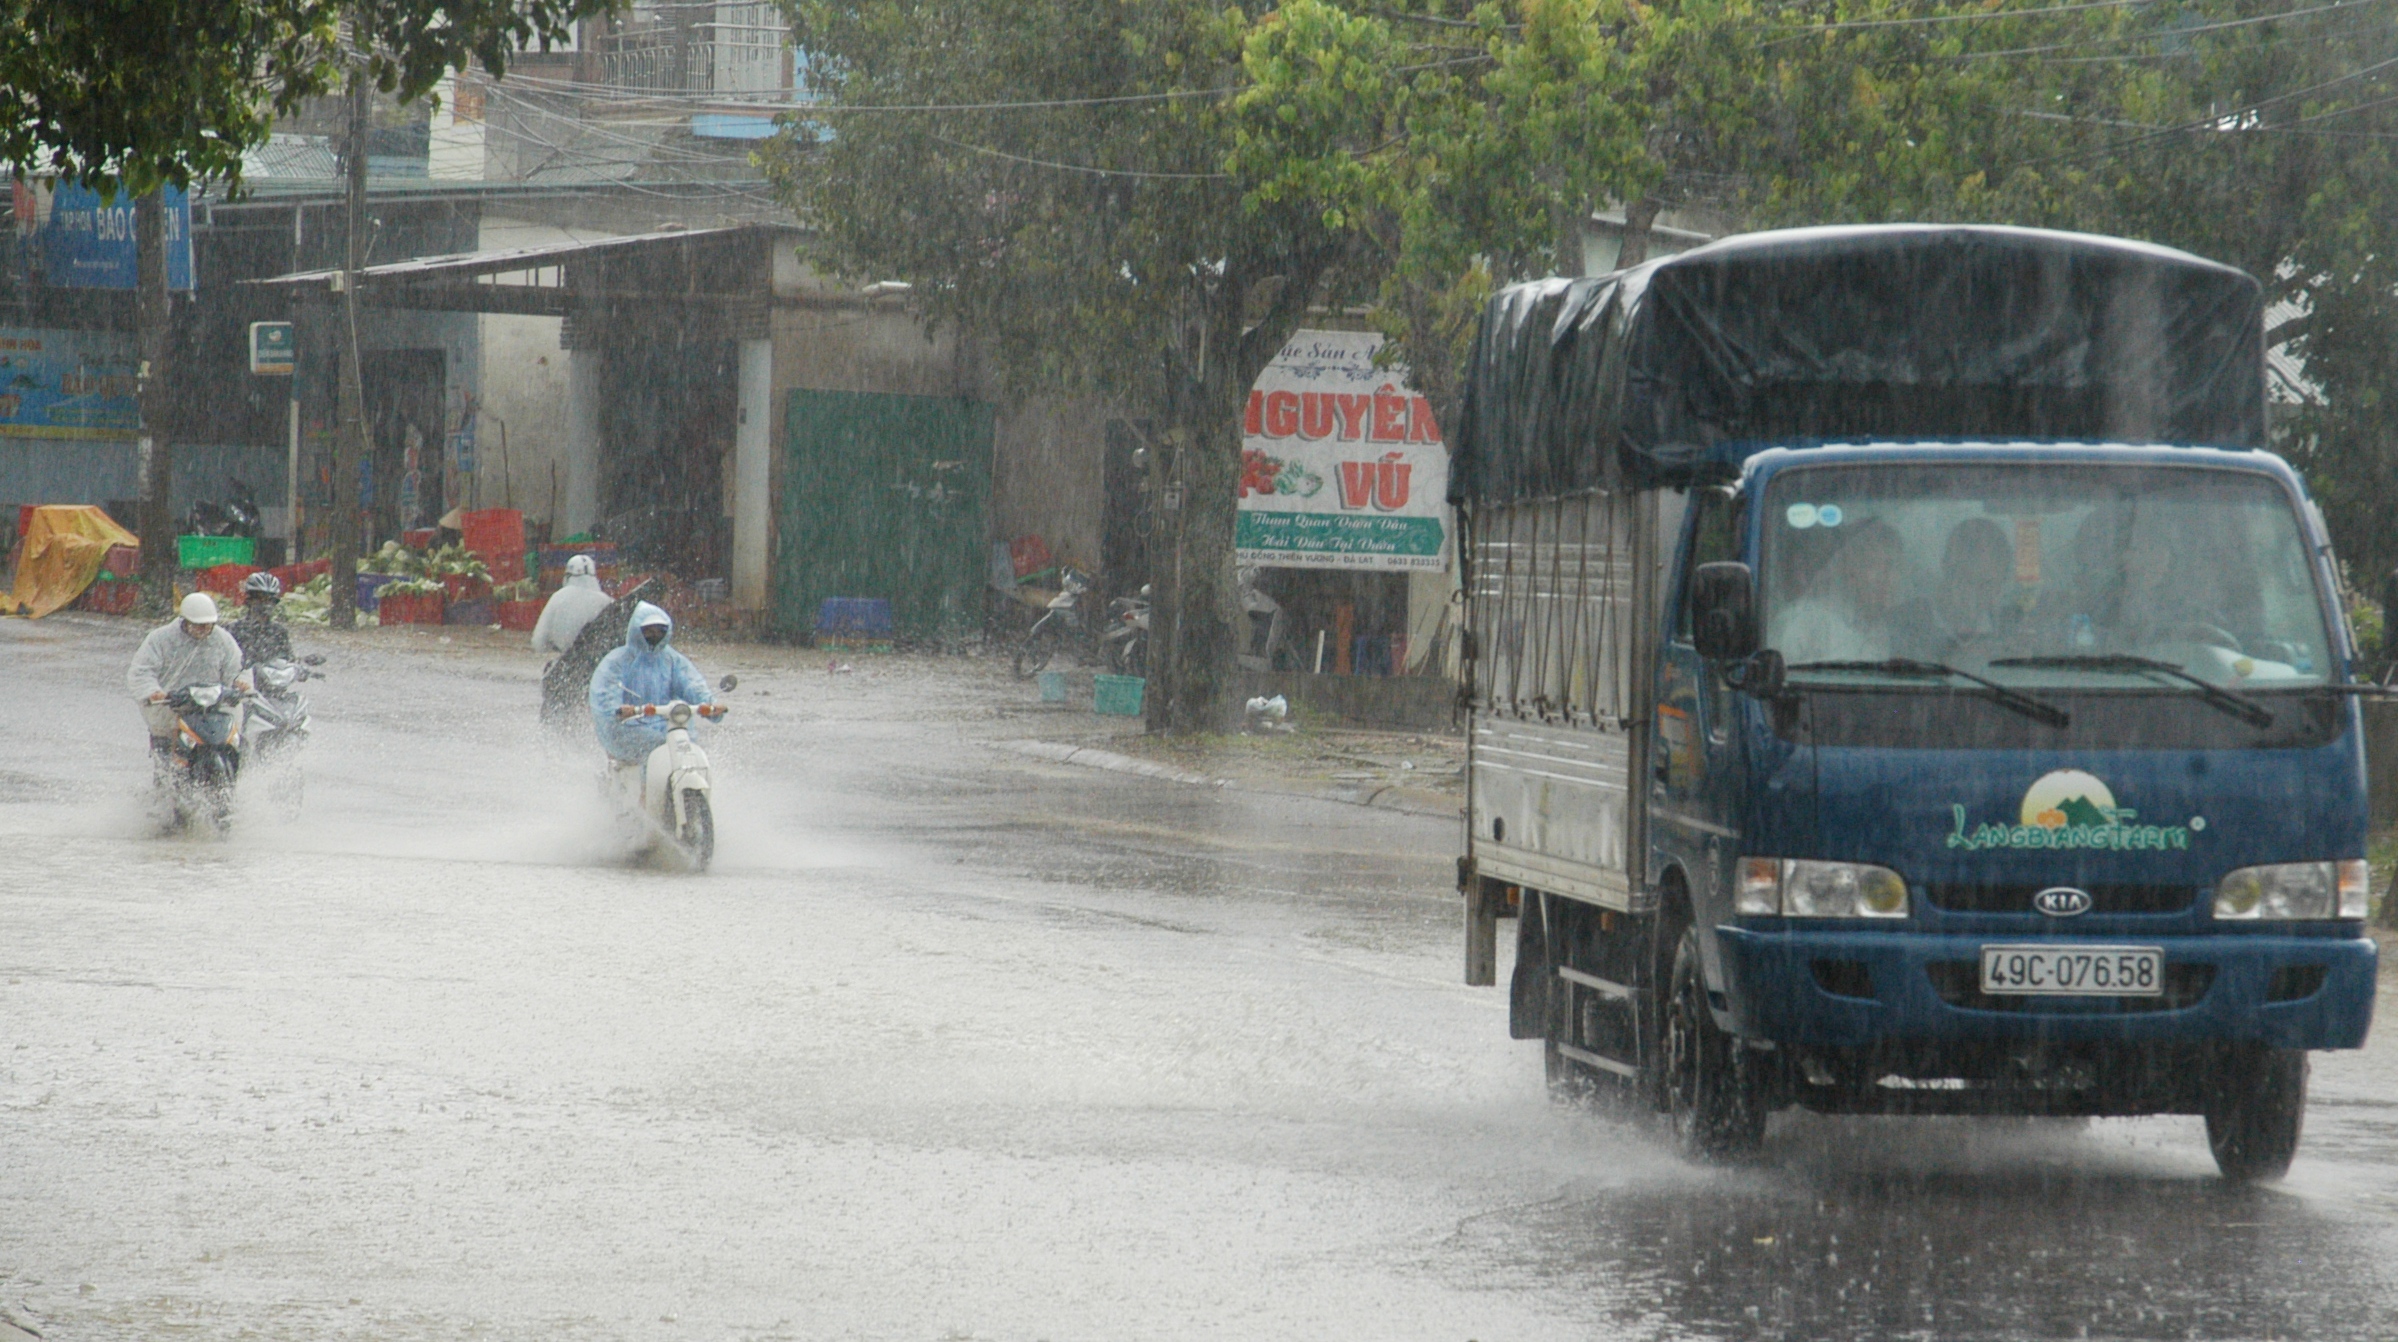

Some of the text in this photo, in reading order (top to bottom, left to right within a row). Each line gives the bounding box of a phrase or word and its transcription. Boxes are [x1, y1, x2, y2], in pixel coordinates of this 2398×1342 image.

[1336, 451, 1412, 510] VŨ
[1252, 513, 1291, 527] Tham
[1295, 514, 1330, 528] Quan
[2043, 894, 2084, 909] KIA
[1989, 954, 2154, 988] 49C-076.58
